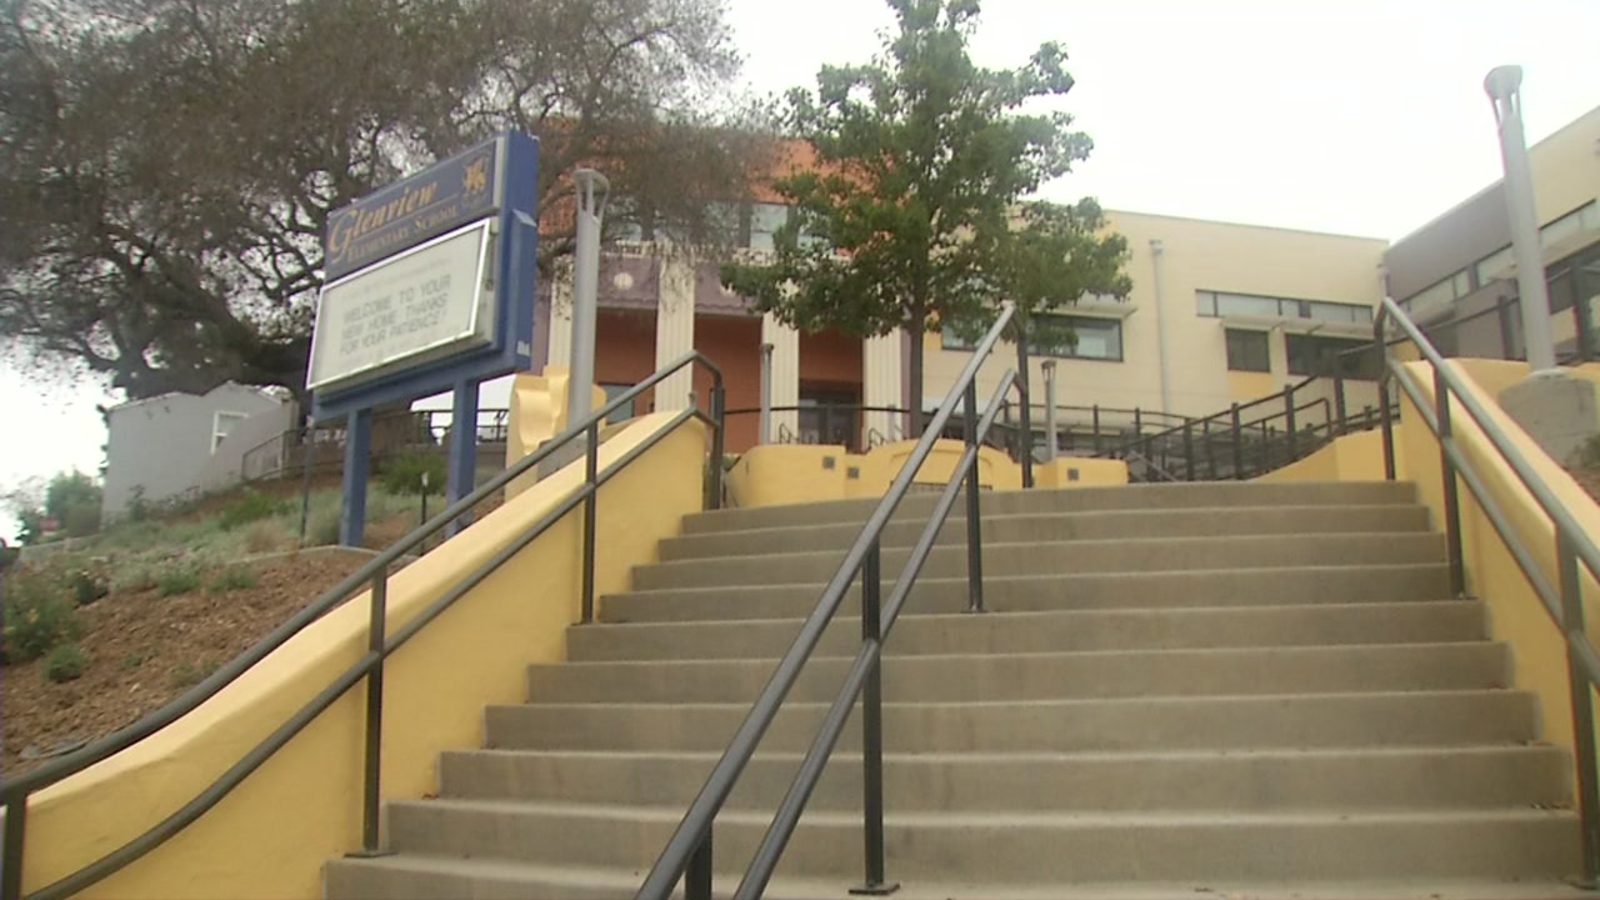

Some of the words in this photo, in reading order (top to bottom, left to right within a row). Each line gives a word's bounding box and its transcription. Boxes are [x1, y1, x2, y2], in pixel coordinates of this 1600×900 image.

[330, 181, 439, 264] Glenview
[343, 295, 391, 324] WELCOME
[399, 287, 415, 304] TO
[420, 274, 451, 296] YOUR
[406, 292, 448, 318] THANKS
[340, 339, 359, 355] FOR
[362, 329, 387, 347] YOUR
